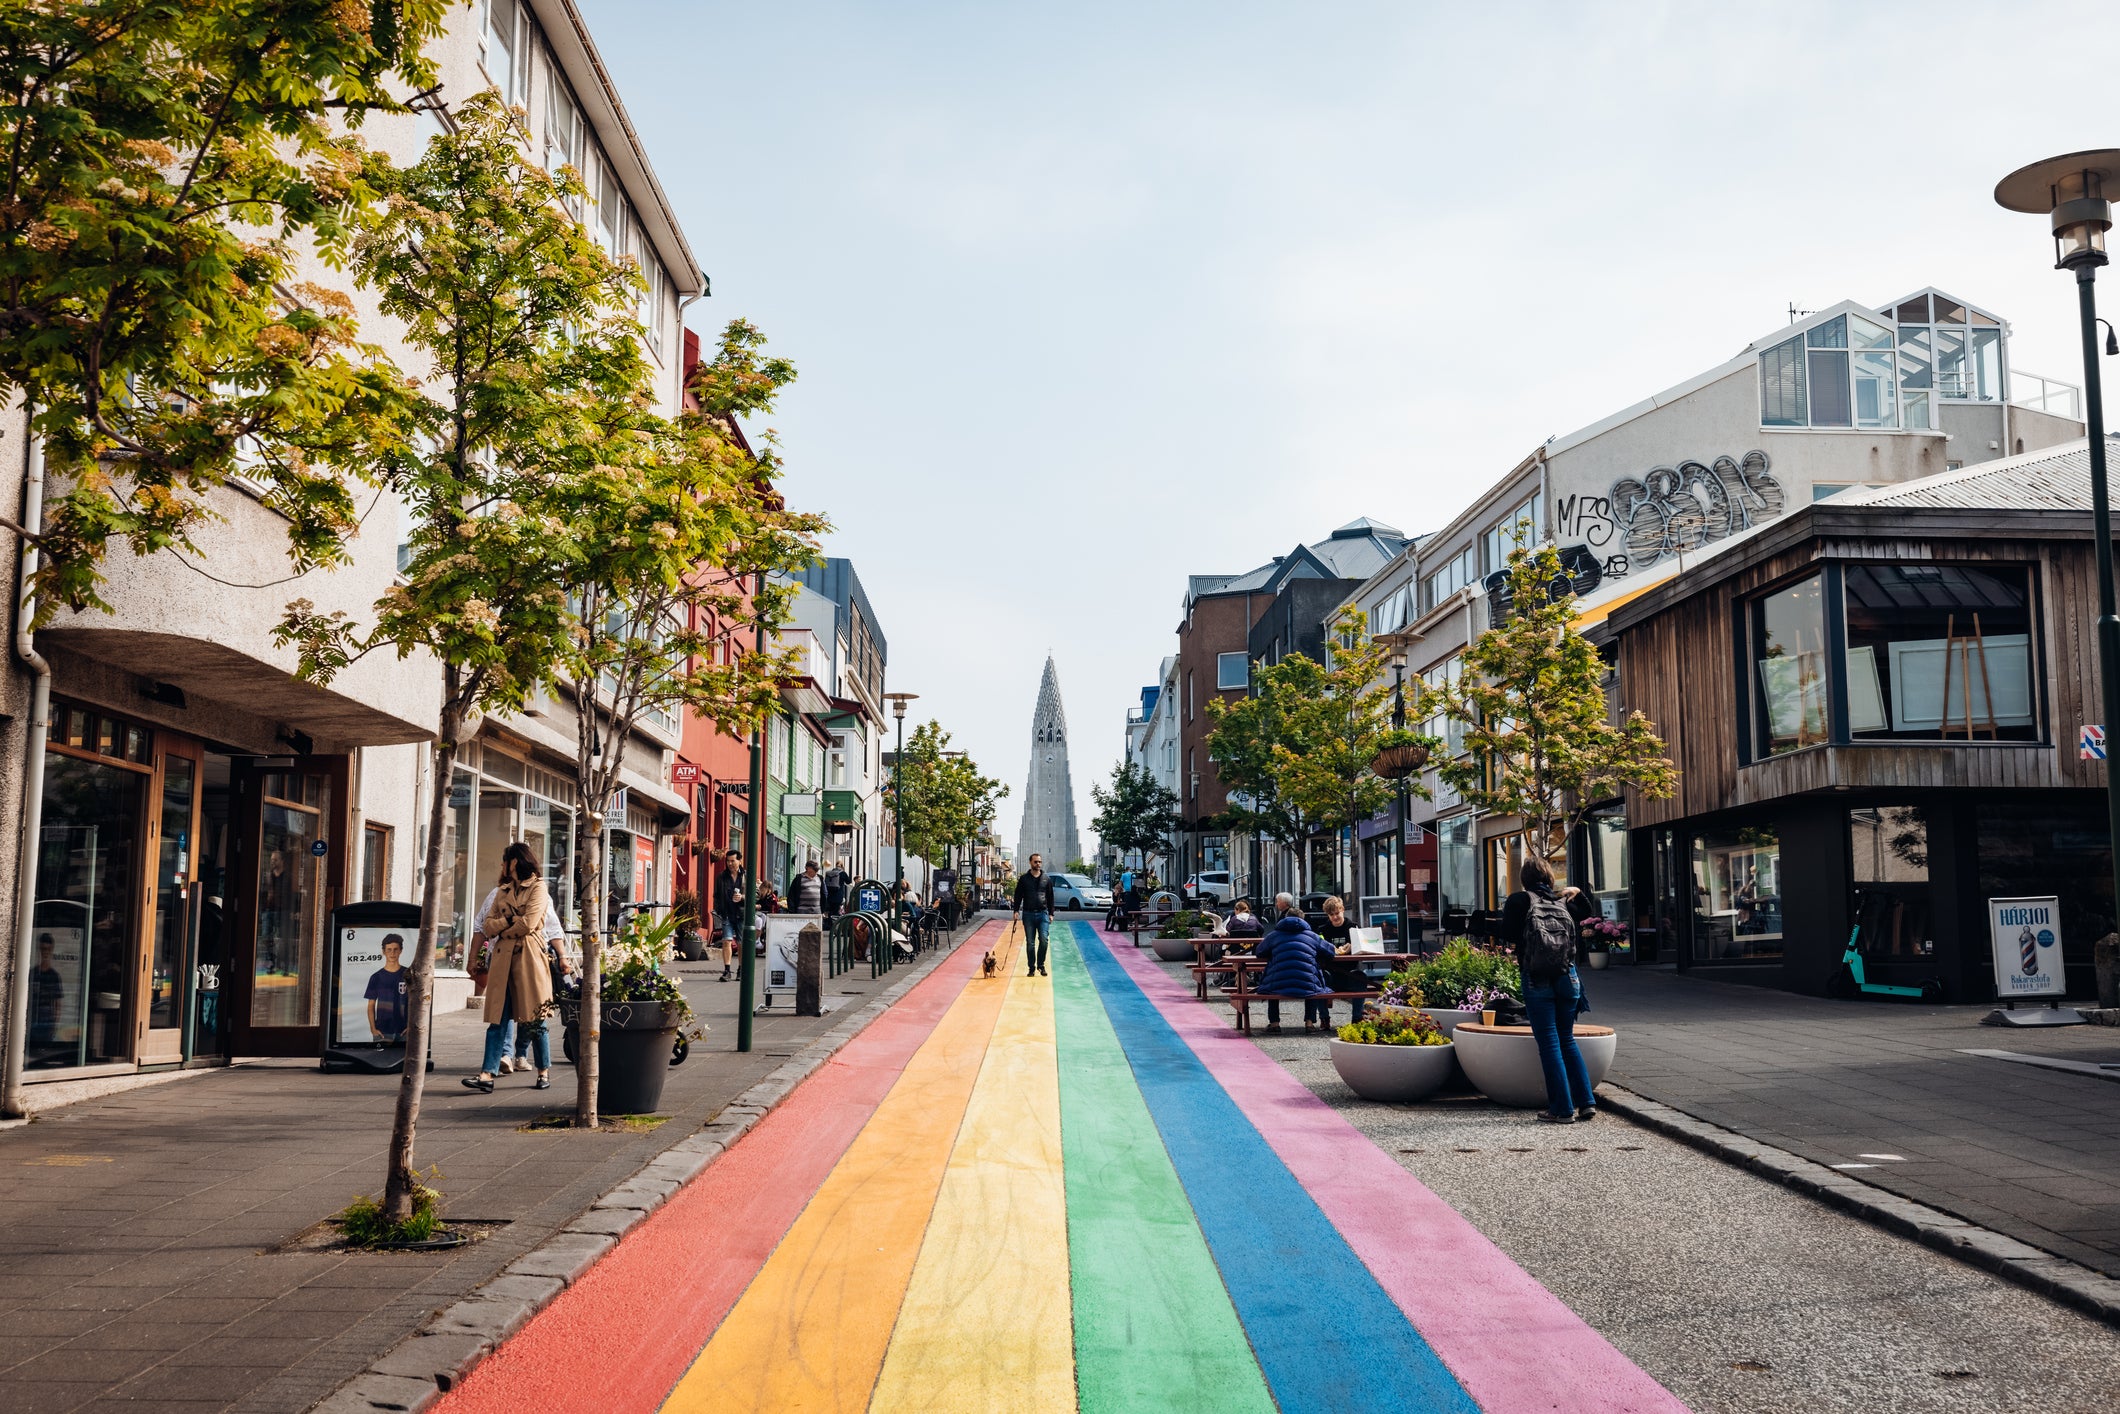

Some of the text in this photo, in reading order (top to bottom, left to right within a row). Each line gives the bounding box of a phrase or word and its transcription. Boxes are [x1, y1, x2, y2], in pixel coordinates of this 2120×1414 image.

[1558, 494, 1614, 547] MFS
[1602, 554, 1629, 577] 18
[676, 766, 697, 776] ATM
[347, 954, 383, 963] KR 2.499
